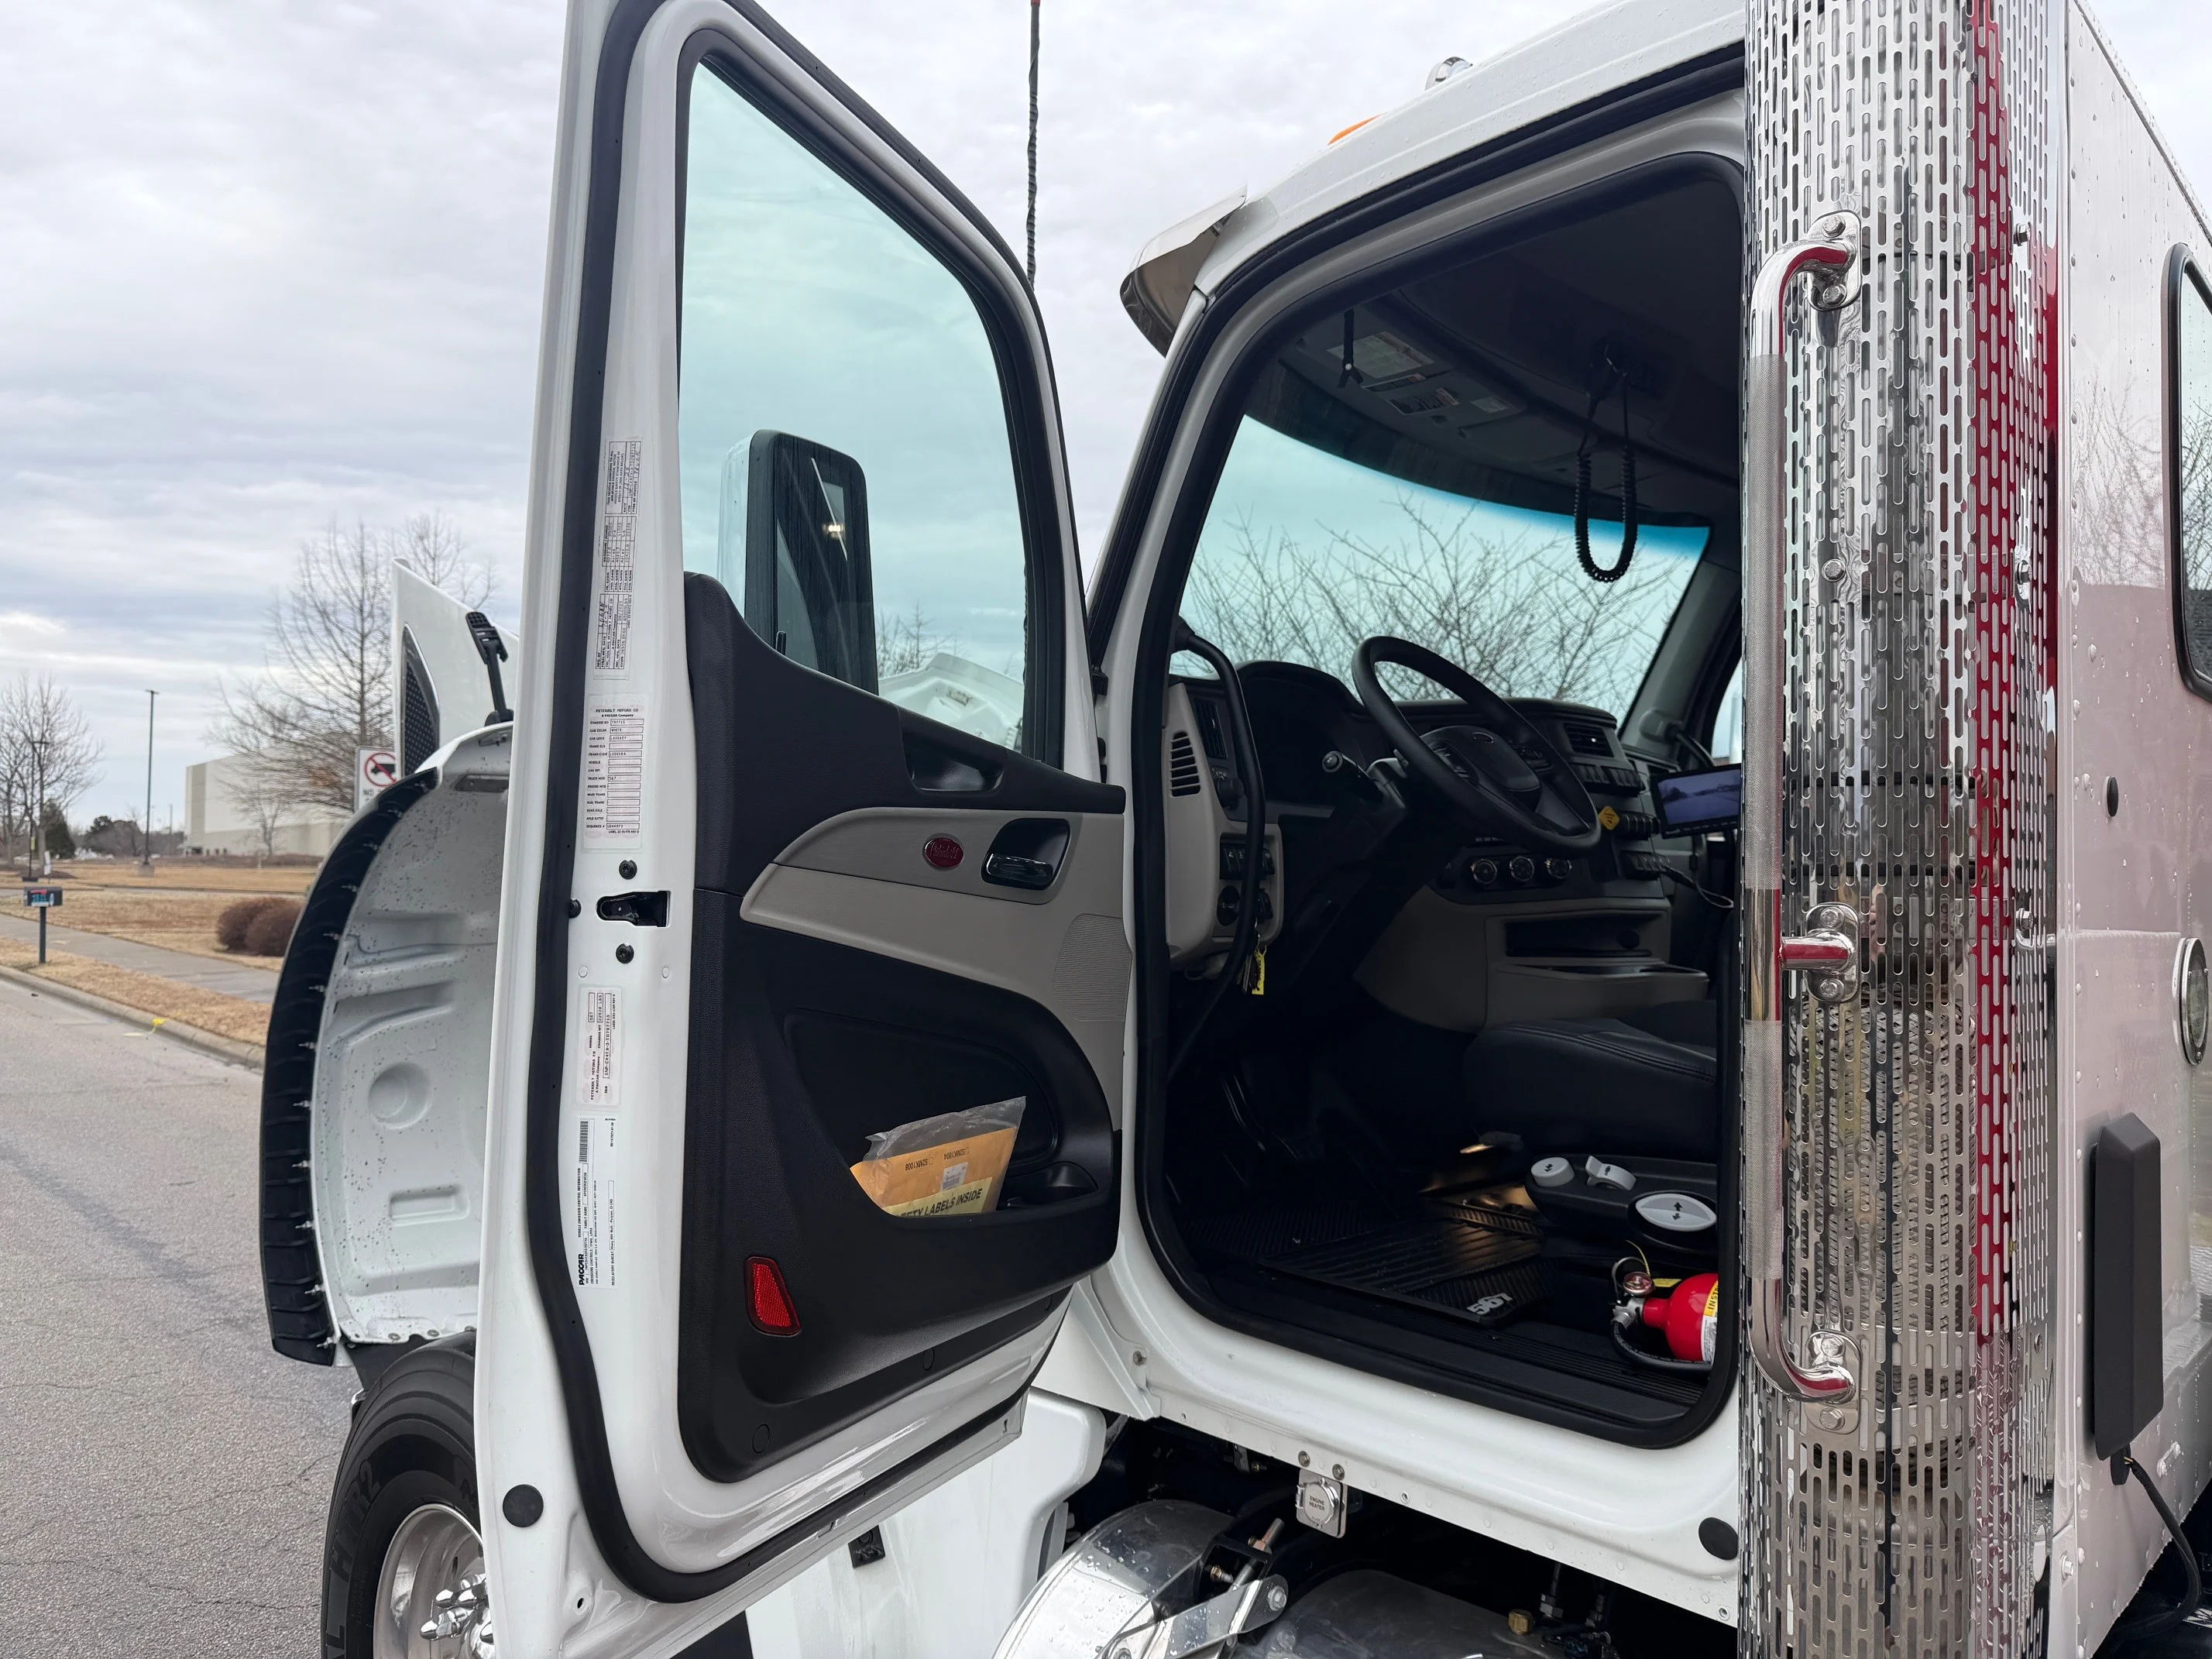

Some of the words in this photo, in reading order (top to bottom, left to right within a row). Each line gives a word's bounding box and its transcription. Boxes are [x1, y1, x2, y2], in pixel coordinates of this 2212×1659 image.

[955, 1188, 982, 1206] INSIDE
[1467, 1293, 1513, 1315] 567
[1309, 1502, 1324, 1511] HEATER
[1310, 1496, 1324, 1505] ENGINE
